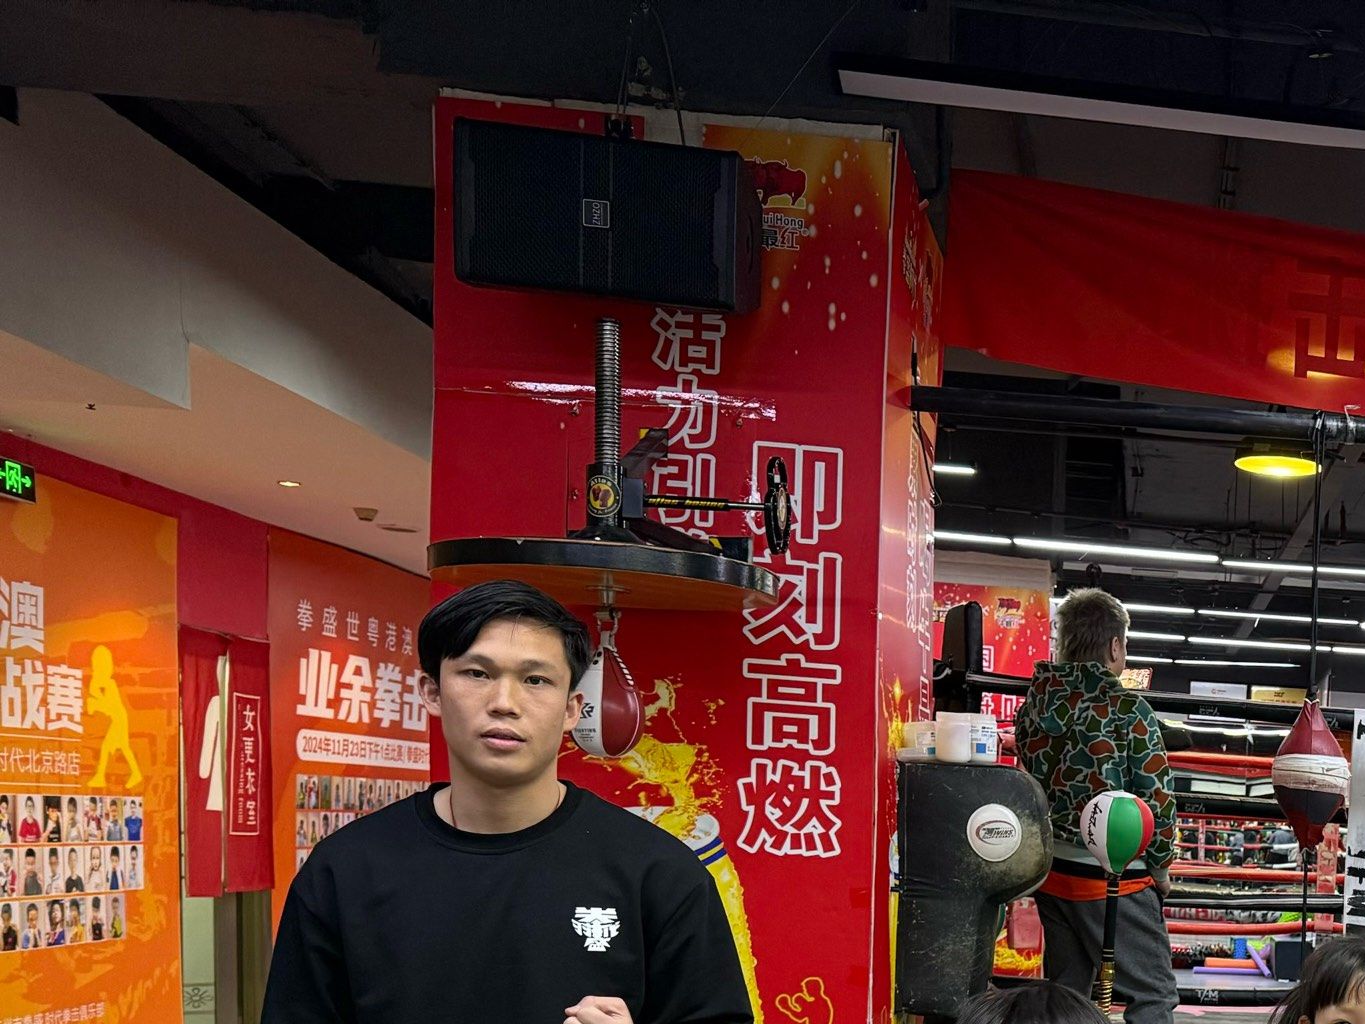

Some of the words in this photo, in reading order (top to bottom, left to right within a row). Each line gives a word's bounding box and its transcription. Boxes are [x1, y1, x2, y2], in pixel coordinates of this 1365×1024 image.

[775, 213, 804, 231] Hong
[761, 226, 800, 252] 最红
[242, 703, 257, 825] 女更衣室
